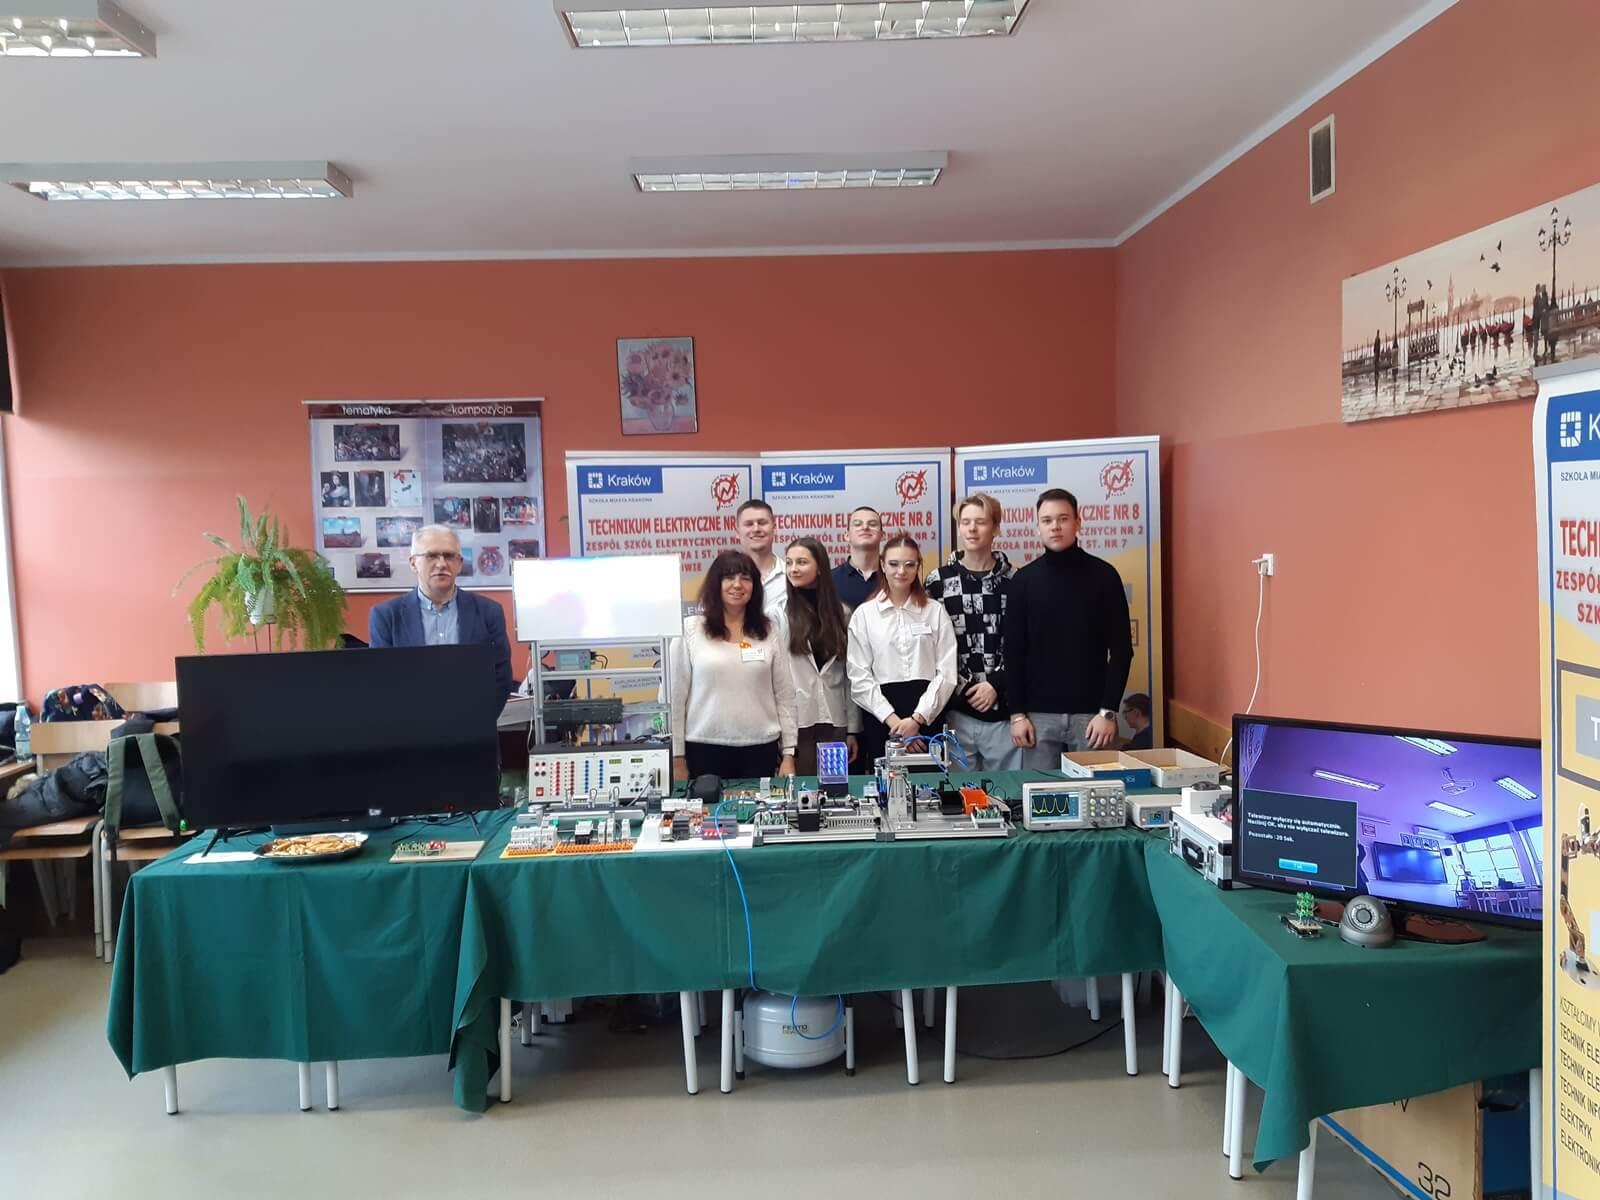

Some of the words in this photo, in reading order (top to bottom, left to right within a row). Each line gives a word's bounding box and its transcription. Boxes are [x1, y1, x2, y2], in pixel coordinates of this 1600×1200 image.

[342, 405, 391, 417] tematyka
[452, 404, 513, 417] kompozycja
[790, 472, 834, 486] Kraków
[991, 466, 1035, 479] Kraków
[1560, 471, 1589, 481] SZKOŁA
[607, 473, 652, 487] Kraków
[908, 512, 921, 527] NR
[926, 511, 932, 526] 8
[1000, 507, 1034, 523] NIKUM
[1113, 504, 1128, 520] NR
[1132, 503, 1139, 520] 8
[588, 517, 651, 536] TECHNIKUM
[654, 515, 721, 533] ELEKTRYCZNE
[1007, 526, 1035, 537] SZKÓŁ
[1120, 525, 1133, 535] NR
[1138, 524, 1143, 535] 2
[931, 531, 936, 539] 2
[586, 539, 621, 551] ZESPÓŁ
[624, 538, 652, 550] SZKÓŁ
[656, 536, 727, 549] ELEKTRYCZNYCH
[1104, 538, 1117, 548] NR
[1121, 538, 1128, 549] 7
[1560, 1021, 1586, 1055] TECHNIK
[1560, 1048, 1586, 1082] TECHNIK
[1560, 1074, 1586, 1110] TECHNIK
[1560, 1102, 1592, 1142] ELEKTRYK
[1418, 1161, 1452, 1200] 32
